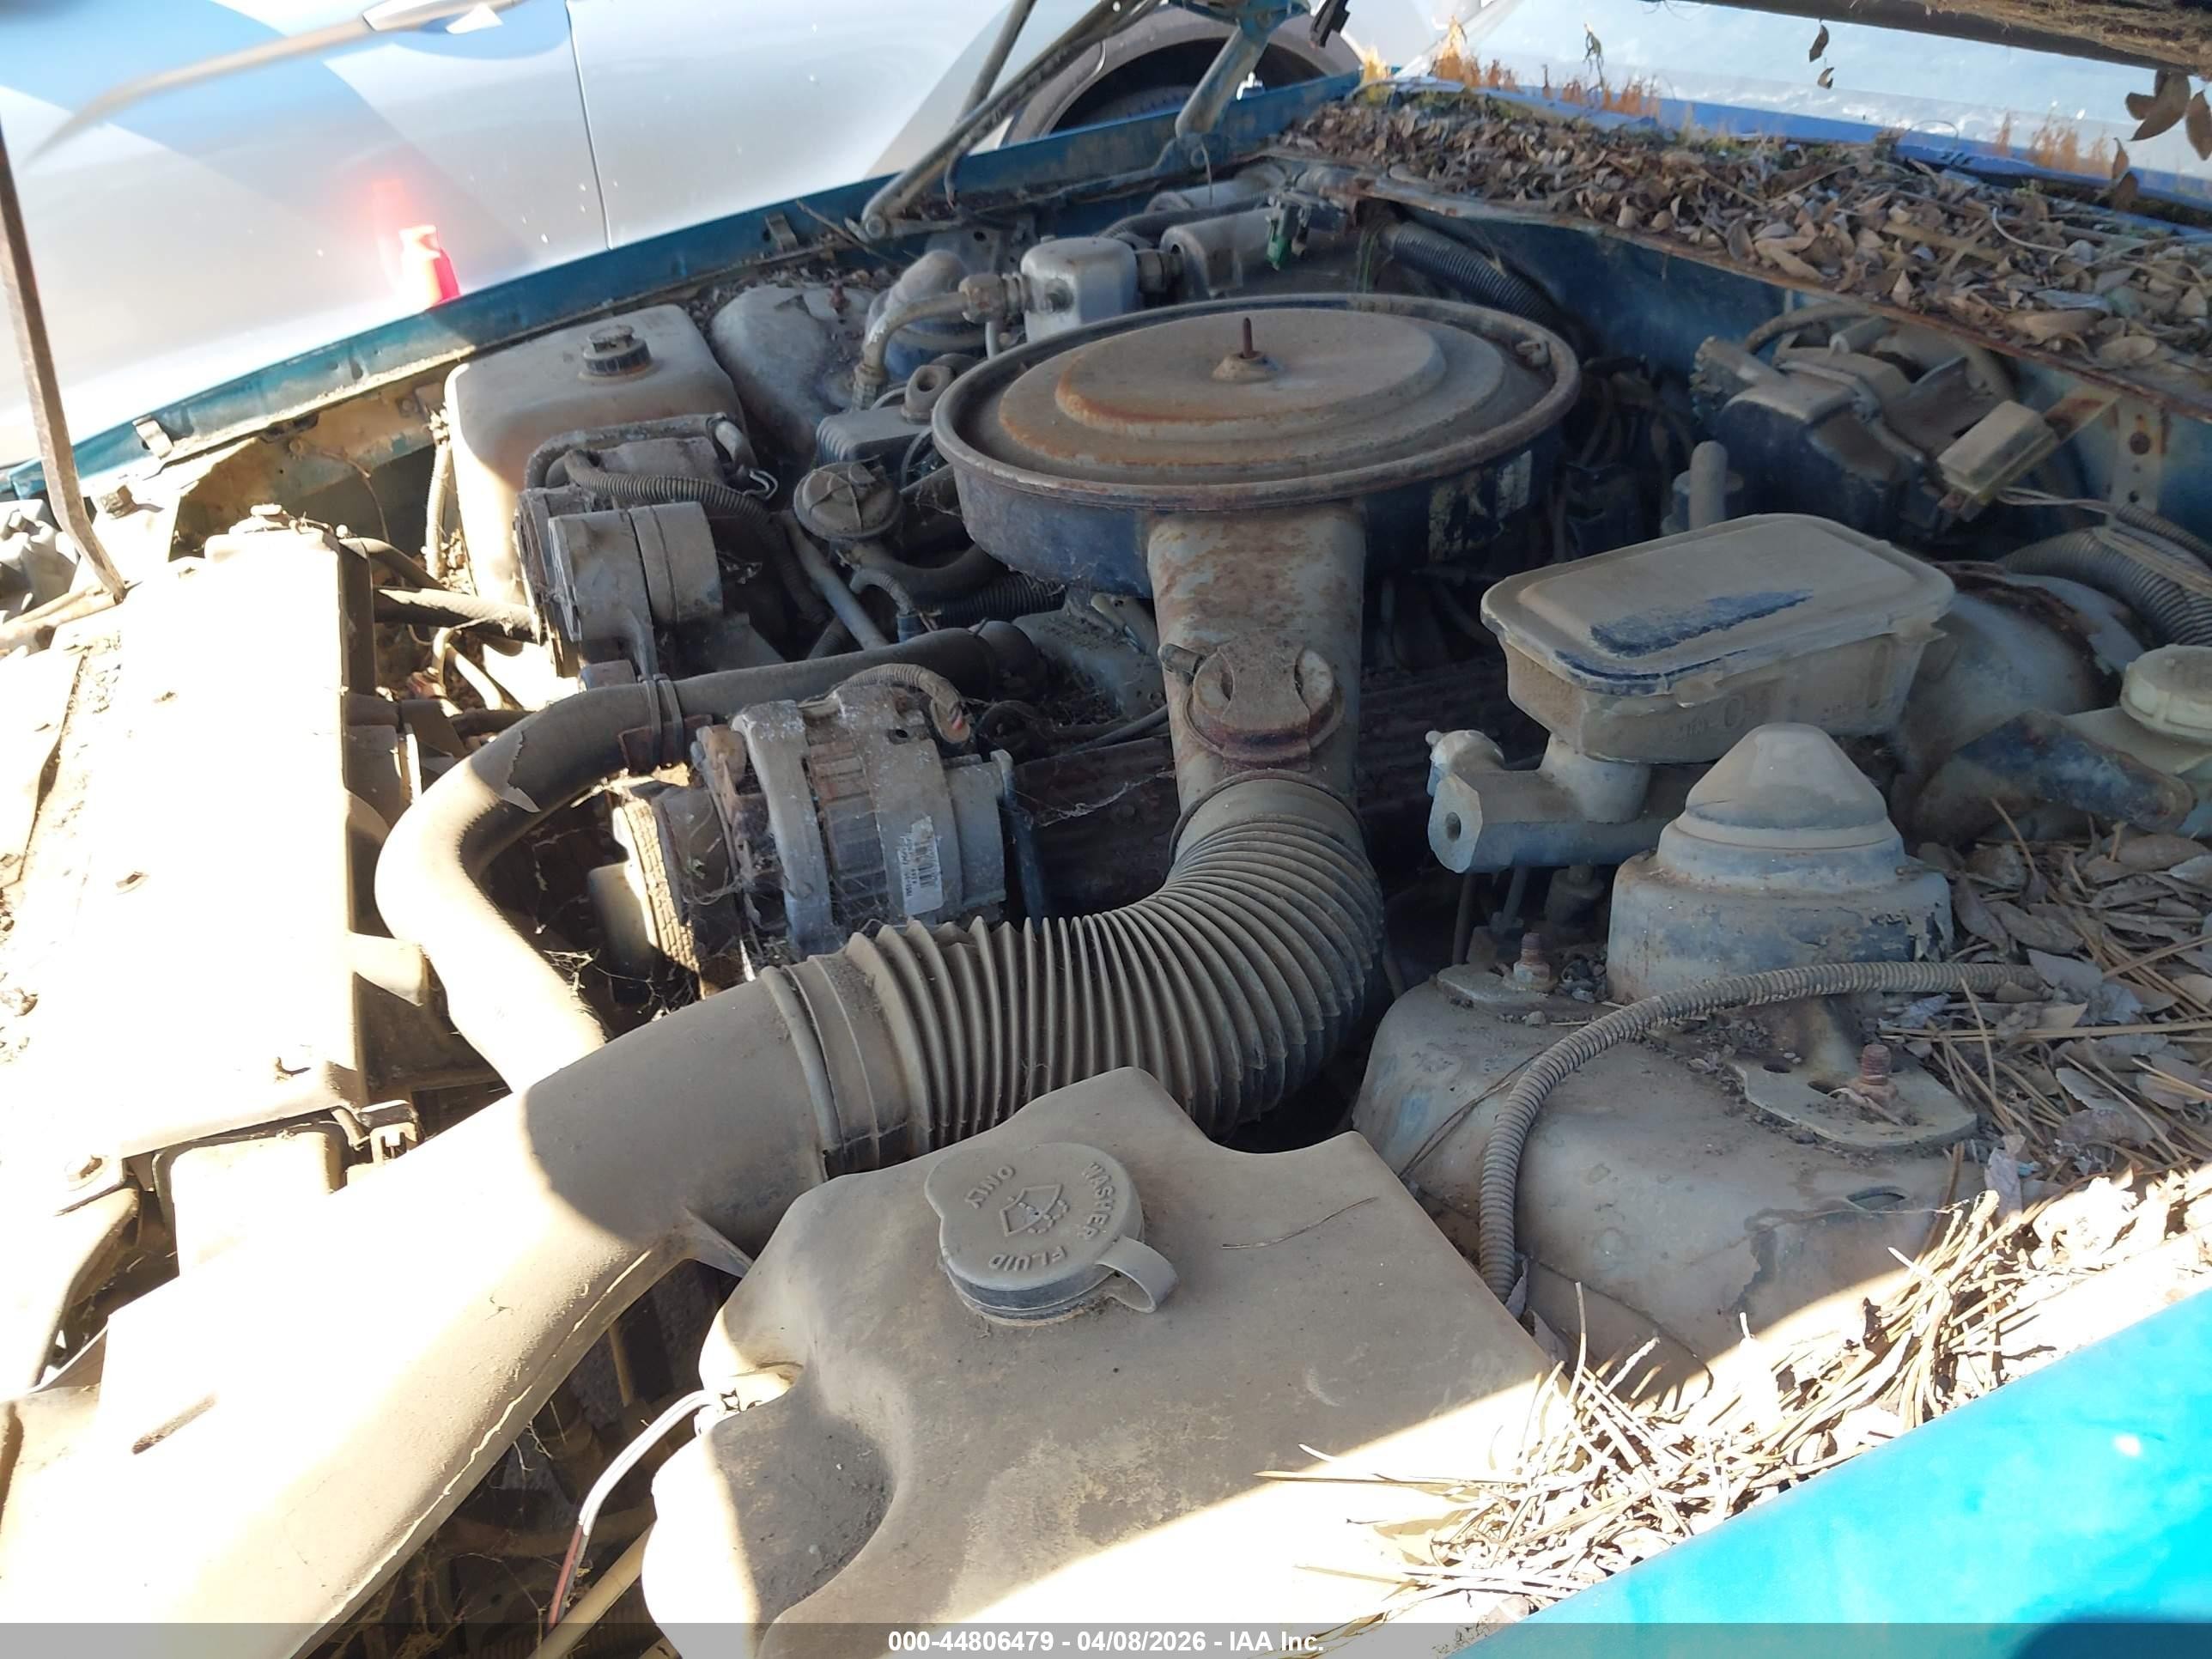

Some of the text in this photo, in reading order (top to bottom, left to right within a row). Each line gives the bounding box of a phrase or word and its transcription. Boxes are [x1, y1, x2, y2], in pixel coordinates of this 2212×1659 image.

[964, 1162, 1116, 1272] WASHER FLUID ONLY
